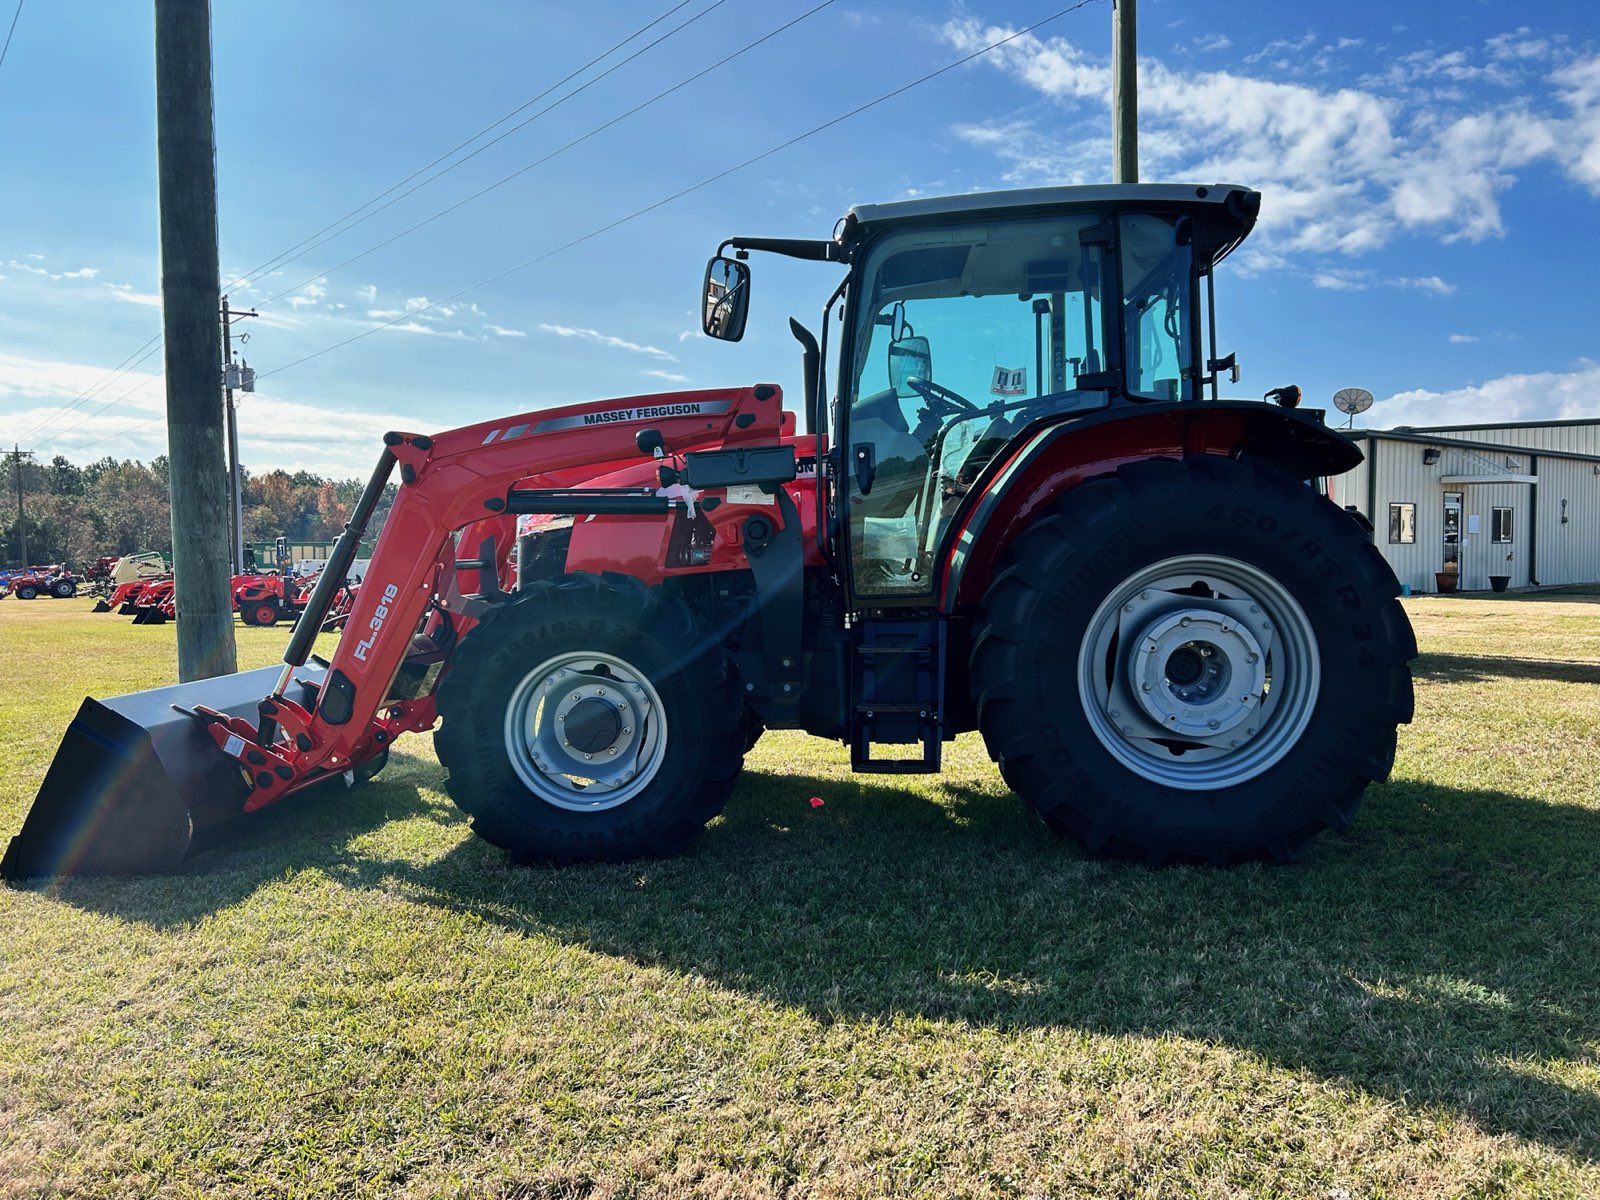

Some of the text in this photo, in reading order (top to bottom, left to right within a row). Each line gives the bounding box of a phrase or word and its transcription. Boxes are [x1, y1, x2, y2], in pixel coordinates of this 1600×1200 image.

[584, 403, 701, 425] MASSEY FERGUSON
[353, 584, 398, 661] FL.3819
